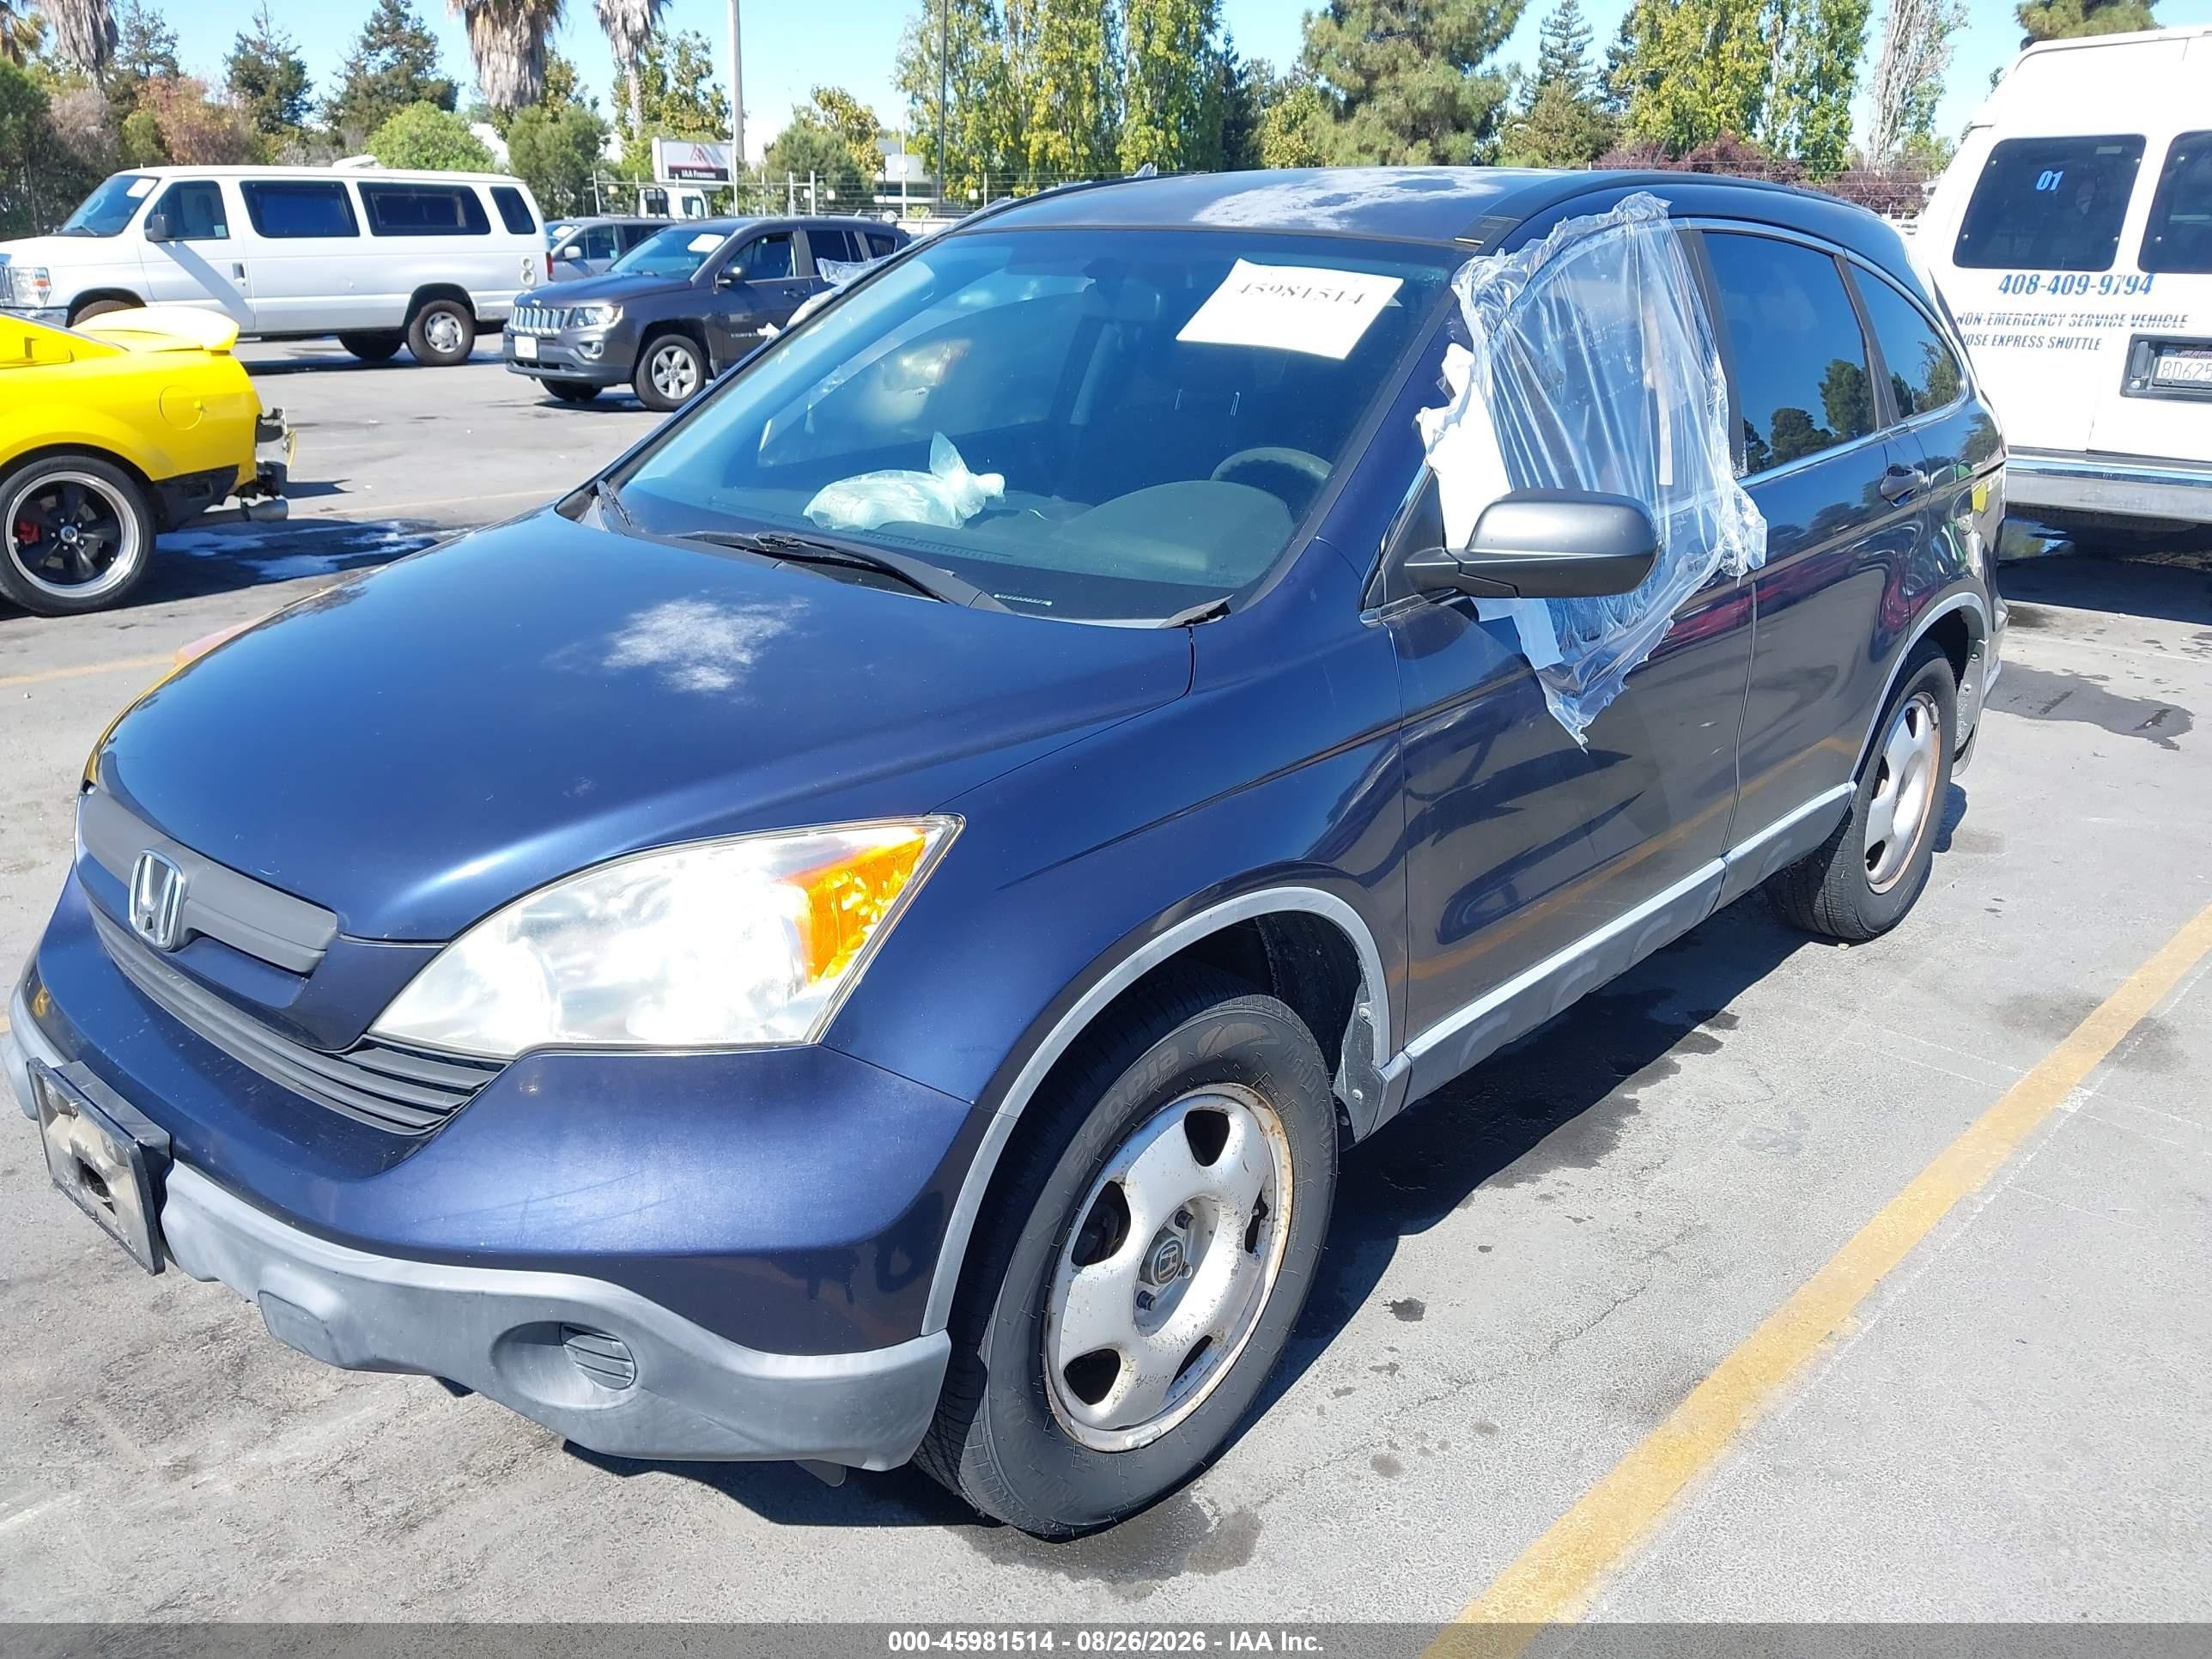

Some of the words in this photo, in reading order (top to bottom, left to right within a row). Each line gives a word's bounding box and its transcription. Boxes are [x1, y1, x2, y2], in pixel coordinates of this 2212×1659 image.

[2036, 170, 2064, 191] 01
[1998, 273, 2155, 295] 408-409-9794
[1956, 312, 2066, 327] NON-EMERGENCY
[2069, 313, 2126, 328] SERVICE
[2130, 313, 2189, 328] VEHICLE
[1991, 334, 2045, 349] EXPRESS
[2047, 336, 2103, 350] SHUTTLE
